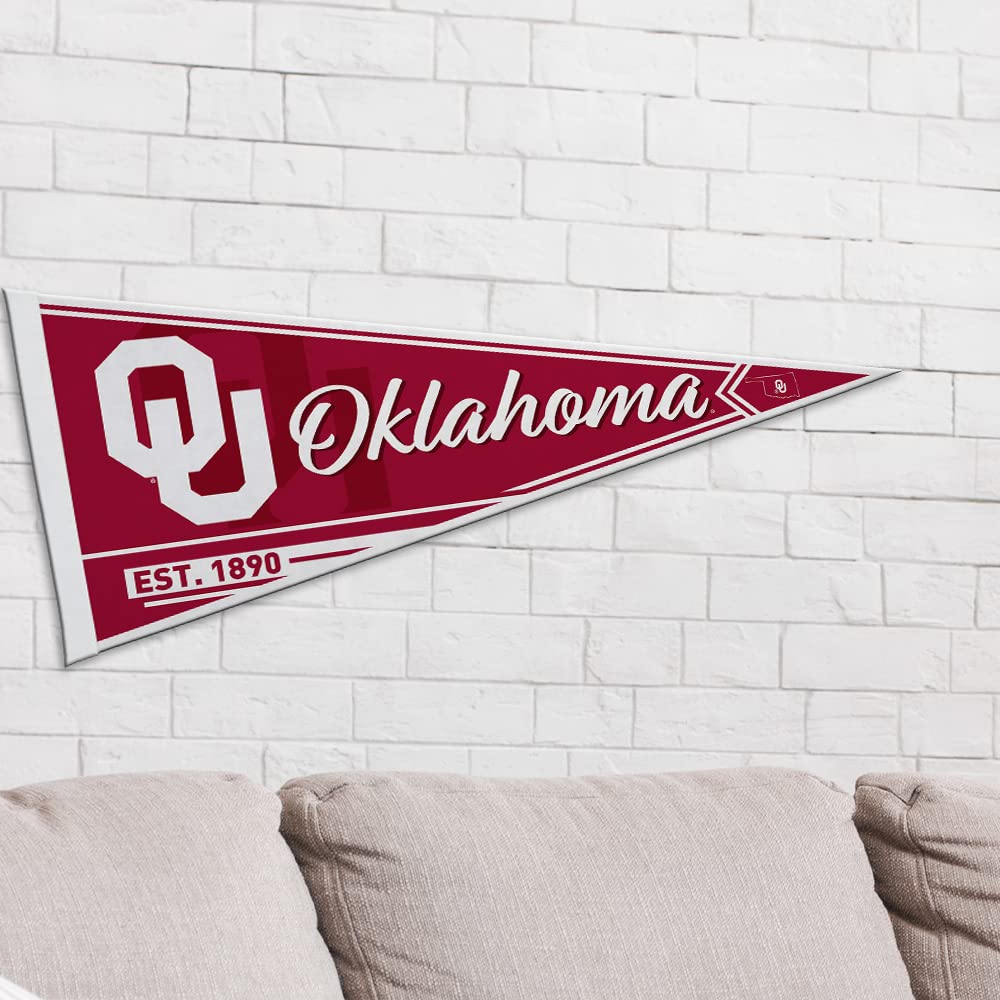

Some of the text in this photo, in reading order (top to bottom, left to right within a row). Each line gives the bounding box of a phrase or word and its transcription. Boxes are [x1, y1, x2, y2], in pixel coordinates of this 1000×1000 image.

[94, 335, 278, 526] OU
[288, 369, 710, 477] Oklahoma
[133, 551, 282, 595] EST. 1890
